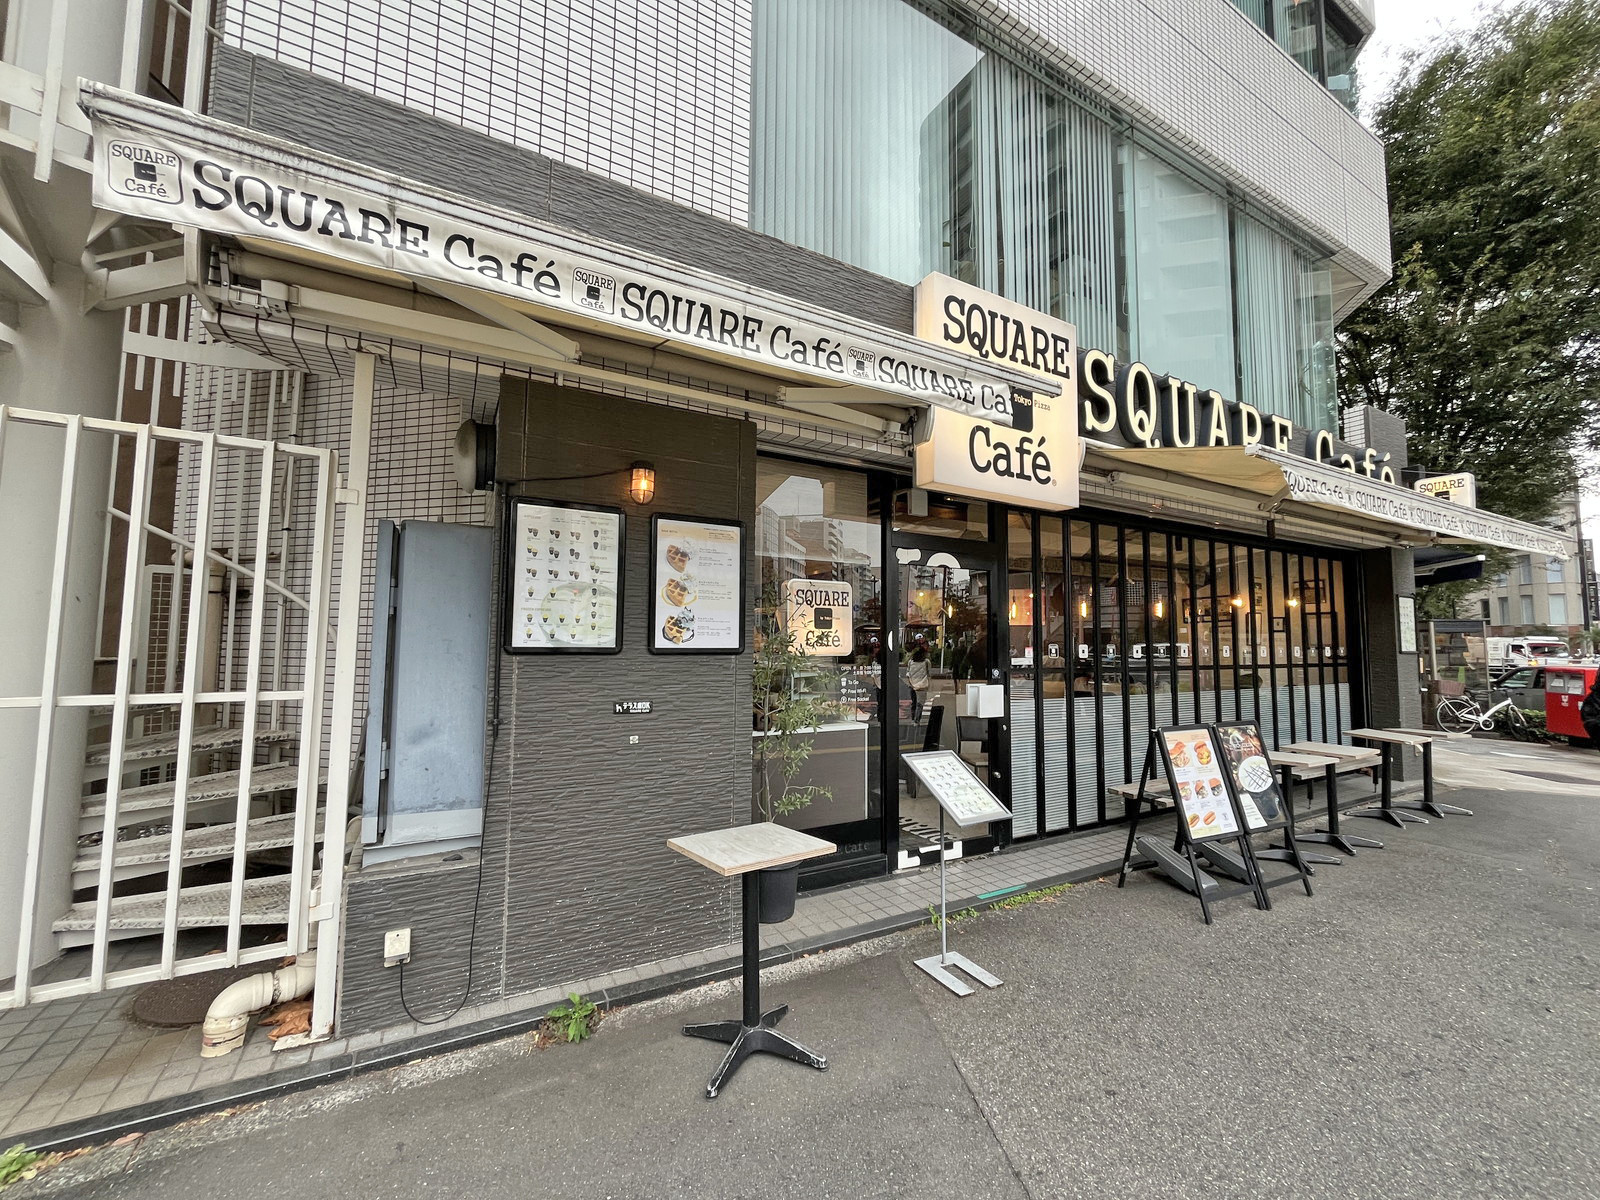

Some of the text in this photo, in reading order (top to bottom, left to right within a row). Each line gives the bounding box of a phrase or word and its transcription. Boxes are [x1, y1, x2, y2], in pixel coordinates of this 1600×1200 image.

[112, 144, 176, 168] SQUARE
[125, 178, 169, 199] Café
[193, 160, 561, 299] SQUARE Café
[575, 270, 613, 291] SQUARE
[580, 297, 606, 311] Café
[621, 282, 845, 375] SQUARE Café
[943, 295, 1070, 380] SQUARE
[849, 348, 874, 363] SQUARE
[878, 356, 976, 406] SQUARE
[1013, 393, 1051, 411] Tokyo Pizza
[1083, 349, 1293, 449] SQUARE
[969, 425, 1052, 486] Café
[1419, 478, 1465, 494] SQUARE
[1355, 491, 1409, 520] SQUARE Café
[795, 588, 850, 608] SQUARE
